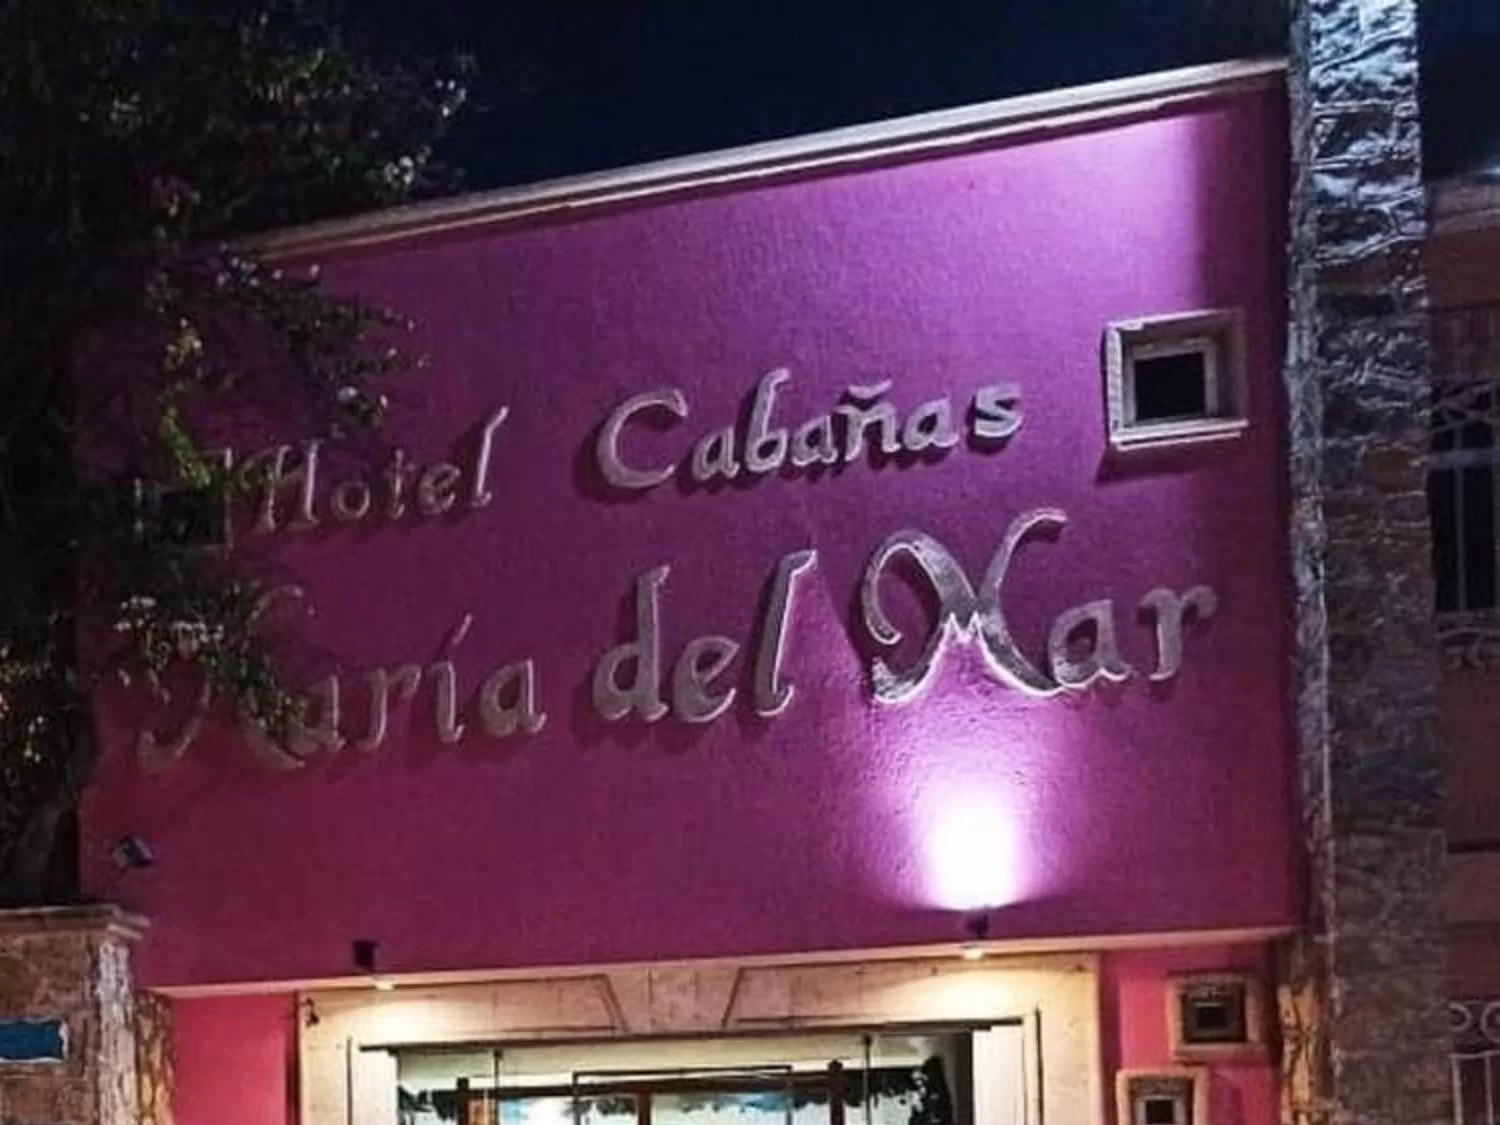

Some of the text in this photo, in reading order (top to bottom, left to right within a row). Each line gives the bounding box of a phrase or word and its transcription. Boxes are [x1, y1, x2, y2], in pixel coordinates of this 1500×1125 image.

[238, 368, 1023, 535] Hotel Cabañas
[593, 549, 816, 725] del
[862, 508, 1218, 703] Mar
